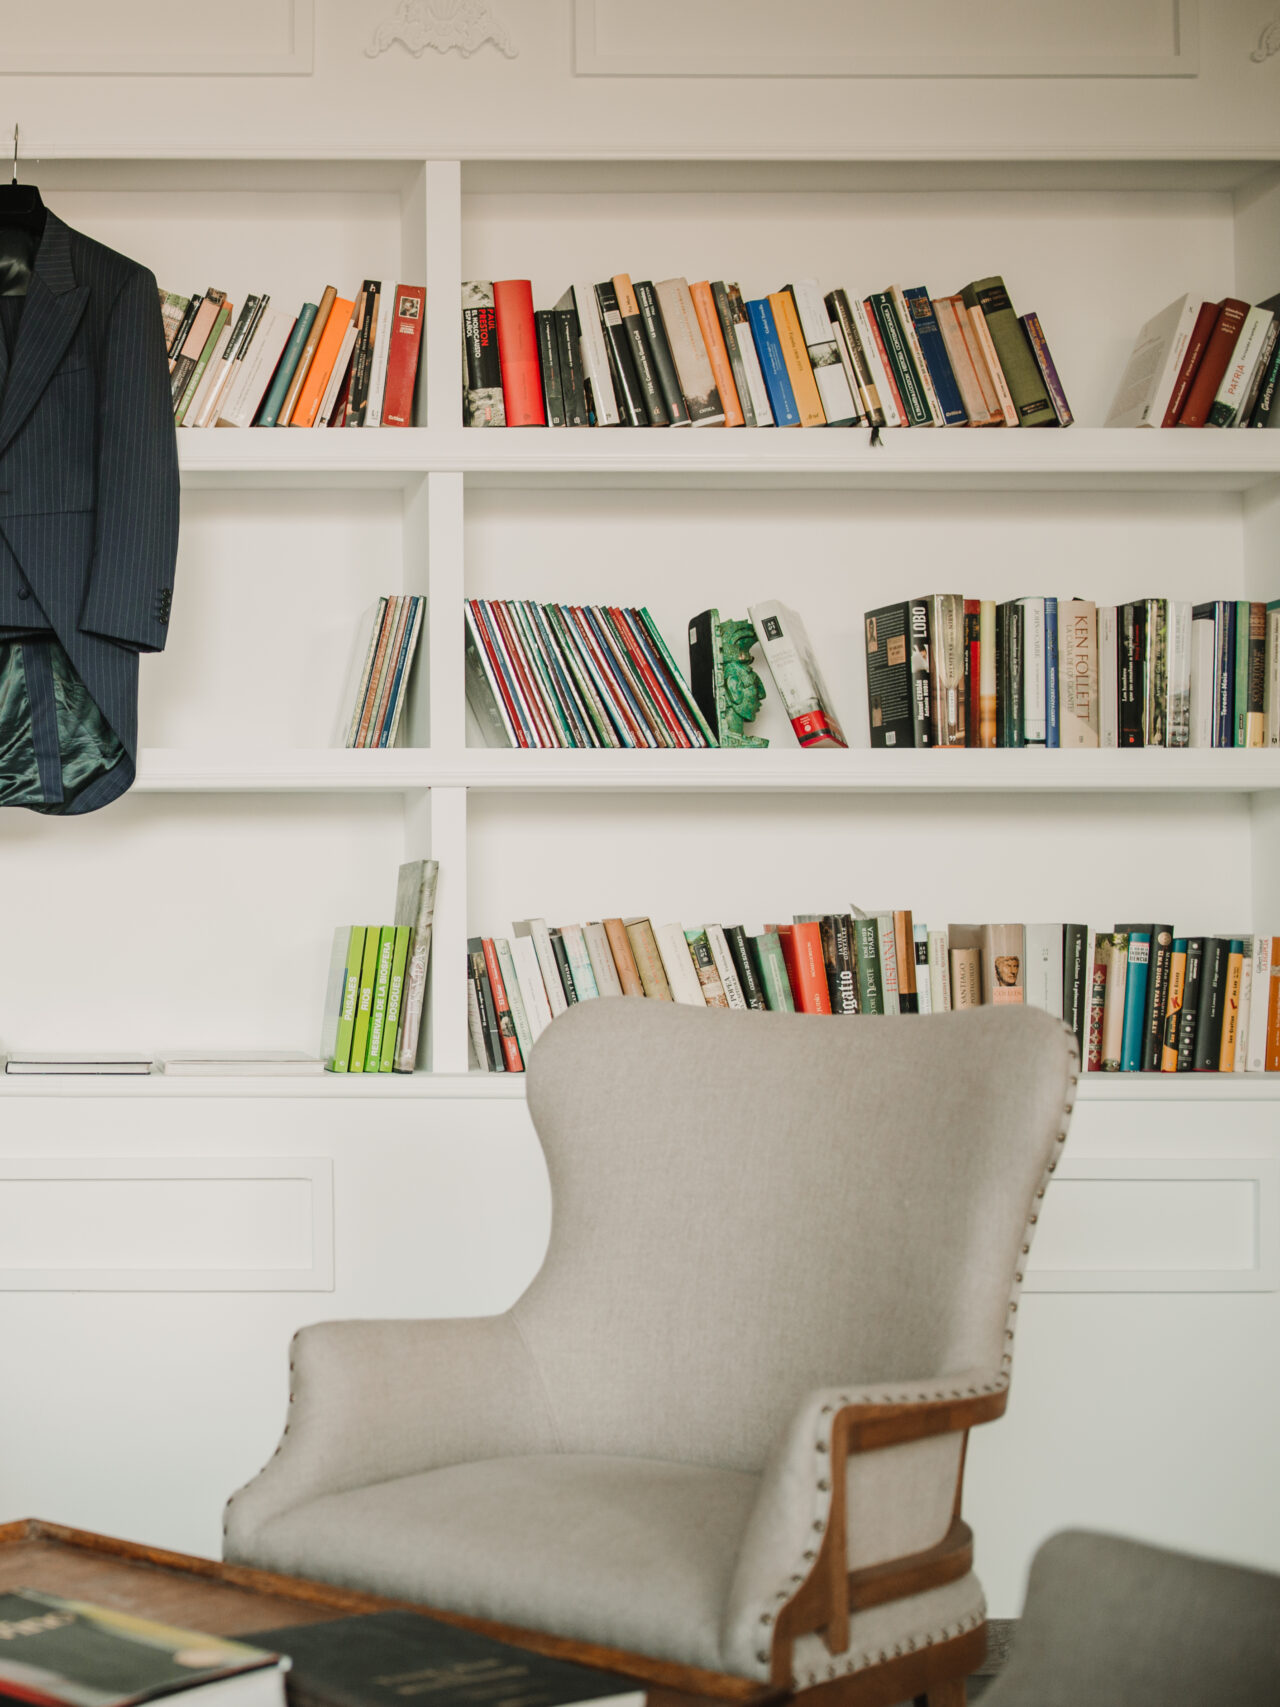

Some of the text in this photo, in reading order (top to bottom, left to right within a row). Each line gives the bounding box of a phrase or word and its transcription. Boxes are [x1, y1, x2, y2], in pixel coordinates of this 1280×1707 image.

[464, 310, 472, 336] ESPAÑOL
[471, 317, 480, 357] HOLOCAUSTO
[478, 309, 488, 346] PRESTON
[486, 308, 495, 329] PAUL
[1227, 363, 1245, 395] PATRIA
[912, 606, 926, 637] LOBO
[1073, 615, 1090, 721] KEN FOLLETT
[916, 701, 924, 720] Manuel
[882, 930, 897, 991] HISPANIA
[344, 976, 357, 1020] PAISAJES
[361, 987, 370, 1011] RIOS
[370, 941, 390, 1056] RESERVAS DE LA BIOSFERA
[388, 975, 401, 1021] BOSQUES
